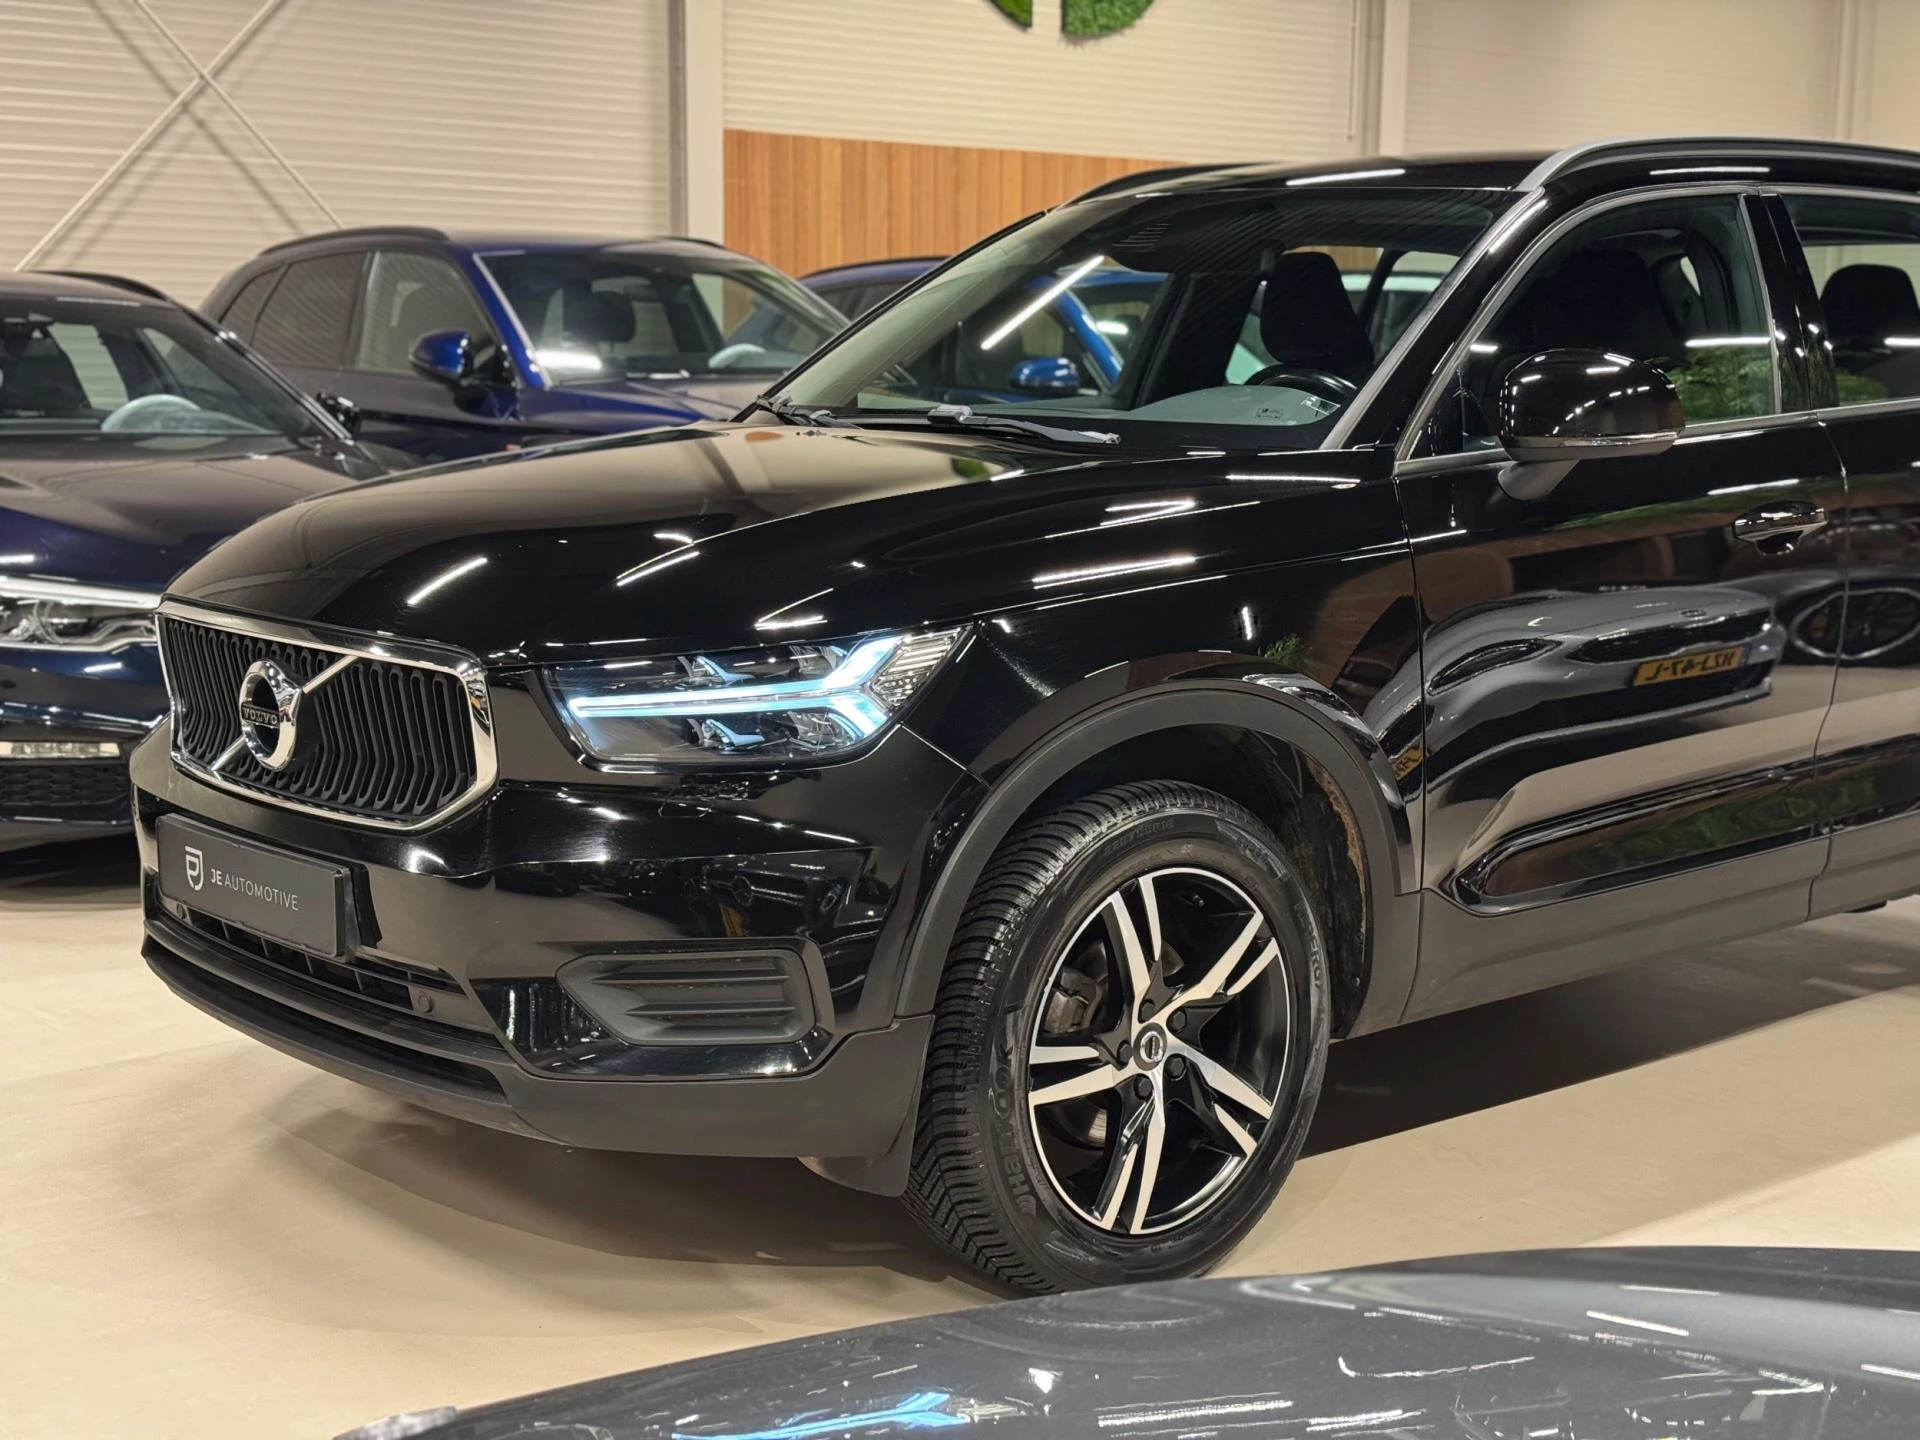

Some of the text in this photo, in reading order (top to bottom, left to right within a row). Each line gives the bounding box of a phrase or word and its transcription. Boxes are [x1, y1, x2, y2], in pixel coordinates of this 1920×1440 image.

[242, 706, 279, 725] VOLVO
[210, 868, 299, 911] JE AUTOMOTIVE
